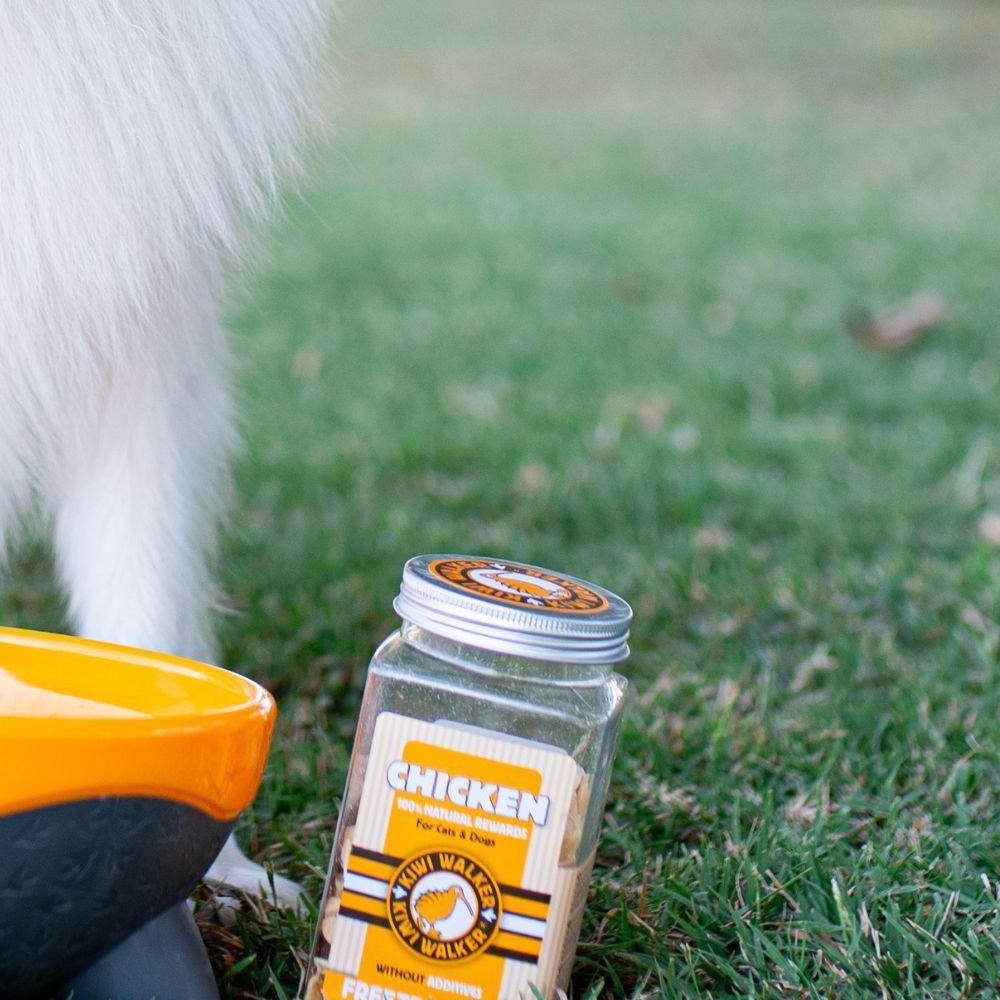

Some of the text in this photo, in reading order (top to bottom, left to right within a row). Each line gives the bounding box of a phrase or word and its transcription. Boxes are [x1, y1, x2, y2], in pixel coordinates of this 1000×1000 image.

[387, 760, 550, 827] CHICKEN
[416, 818, 496, 847] For Cats & Dogs
[423, 803, 473, 828] NATURAL
[474, 816, 529, 840] REWARDS
[398, 853, 496, 909] KIWI WALKER
[392, 901, 488, 959] KIWI WALKER
[376, 962, 483, 999] WITHOUT ADDITIVES
